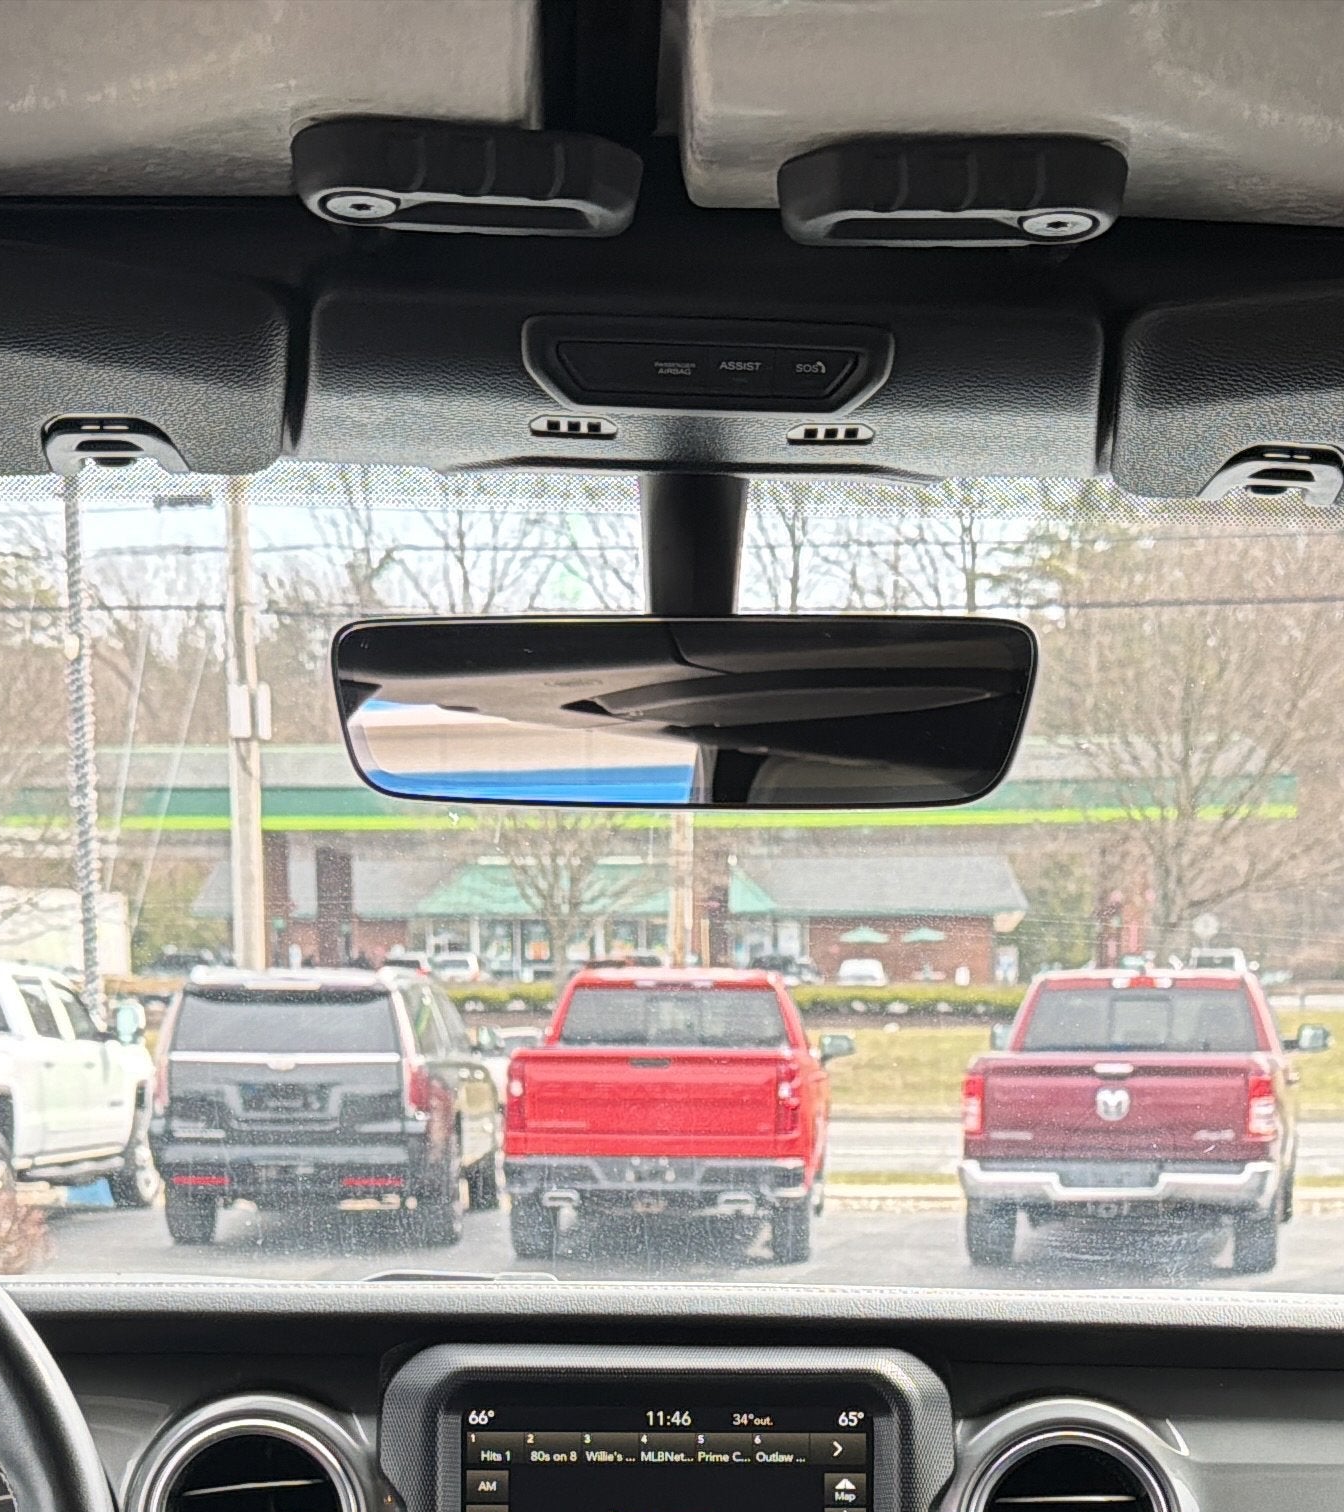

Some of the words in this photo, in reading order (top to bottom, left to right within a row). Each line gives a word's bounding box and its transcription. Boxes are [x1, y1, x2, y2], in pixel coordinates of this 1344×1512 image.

[719, 361, 762, 371] ASSIST
[796, 363, 818, 373] SOS
[657, 368, 692, 376] AIRBAG
[646, 1410, 692, 1426] 11:46
[470, 1433, 476, 1443] 1
[526, 1433, 535, 1444] 2
[584, 1434, 592, 1444] 3
[640, 1434, 648, 1444] 4
[697, 1435, 705, 1444] 5
[754, 1435, 762, 1444] 6
[480, 1451, 503, 1462] Hits
[530, 1451, 550, 1462] 80s
[553, 1453, 568, 1462] on
[570, 1451, 577, 1462] 8
[586, 1451, 623, 1462] Willie's
[698, 1452, 729, 1462] Prime
[755, 1452, 794, 1462] Outlaw
[478, 1481, 497, 1492] AM
[834, 1491, 856, 1503] Map
